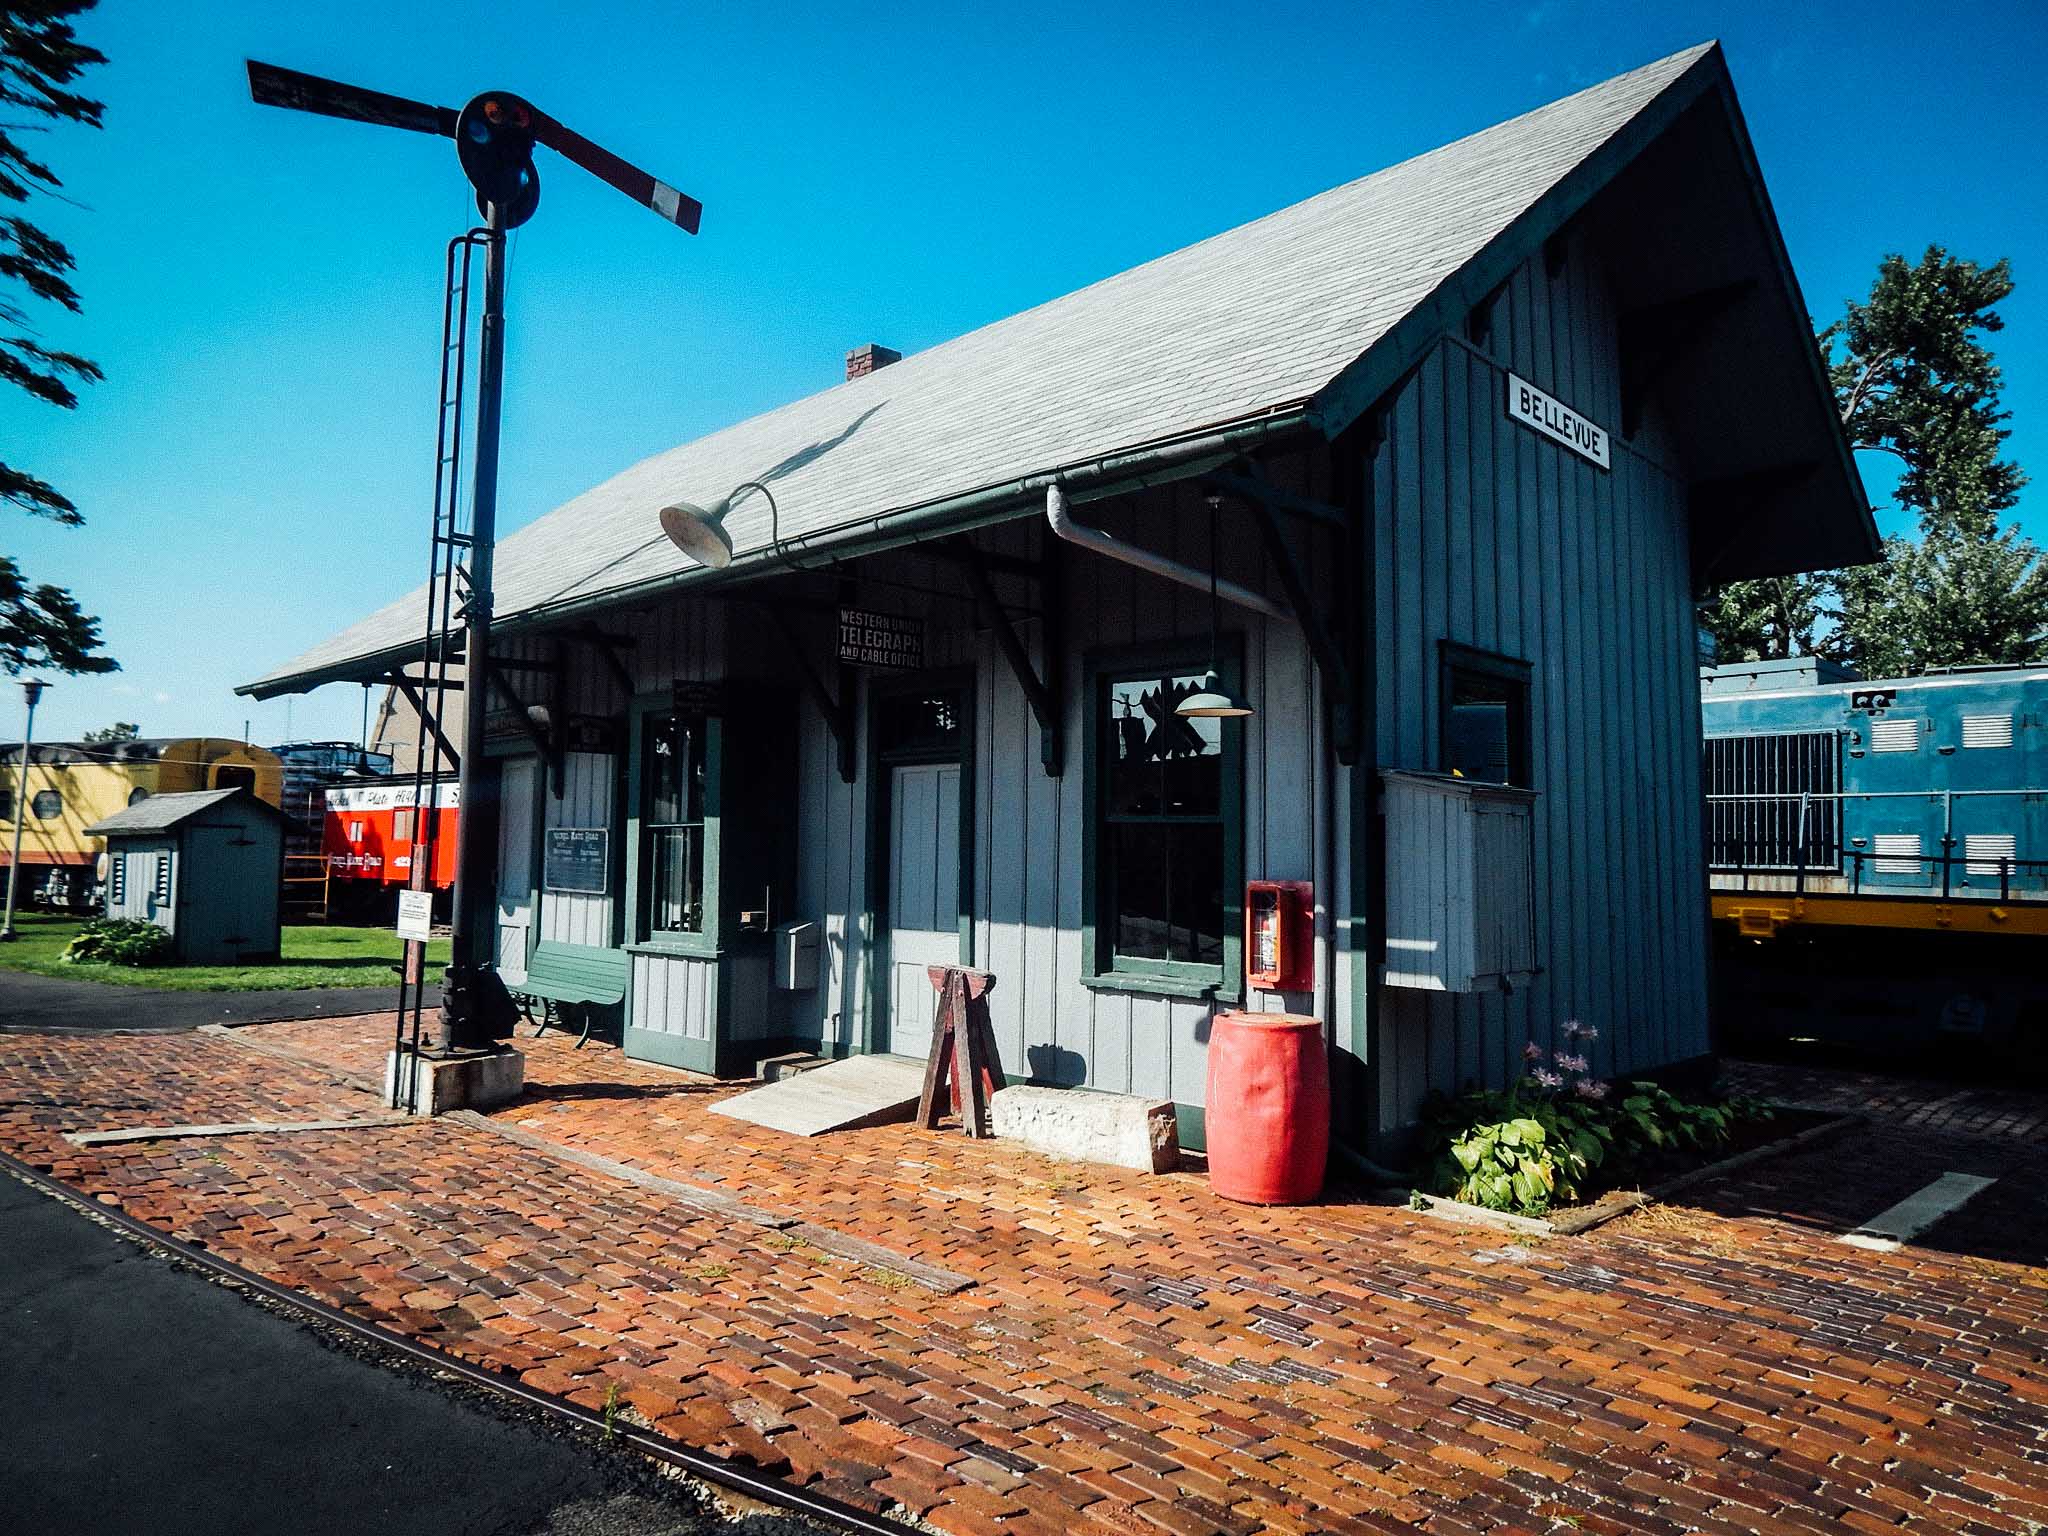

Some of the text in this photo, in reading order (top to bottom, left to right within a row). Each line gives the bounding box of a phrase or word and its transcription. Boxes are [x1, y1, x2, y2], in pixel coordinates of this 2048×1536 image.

[1520, 387, 1601, 457] BELLEVUE
[841, 608, 889, 630] WESTERN
[840, 625, 921, 653] TELEGRAPH
[840, 645, 921, 669] AND CABLE OFFICE
